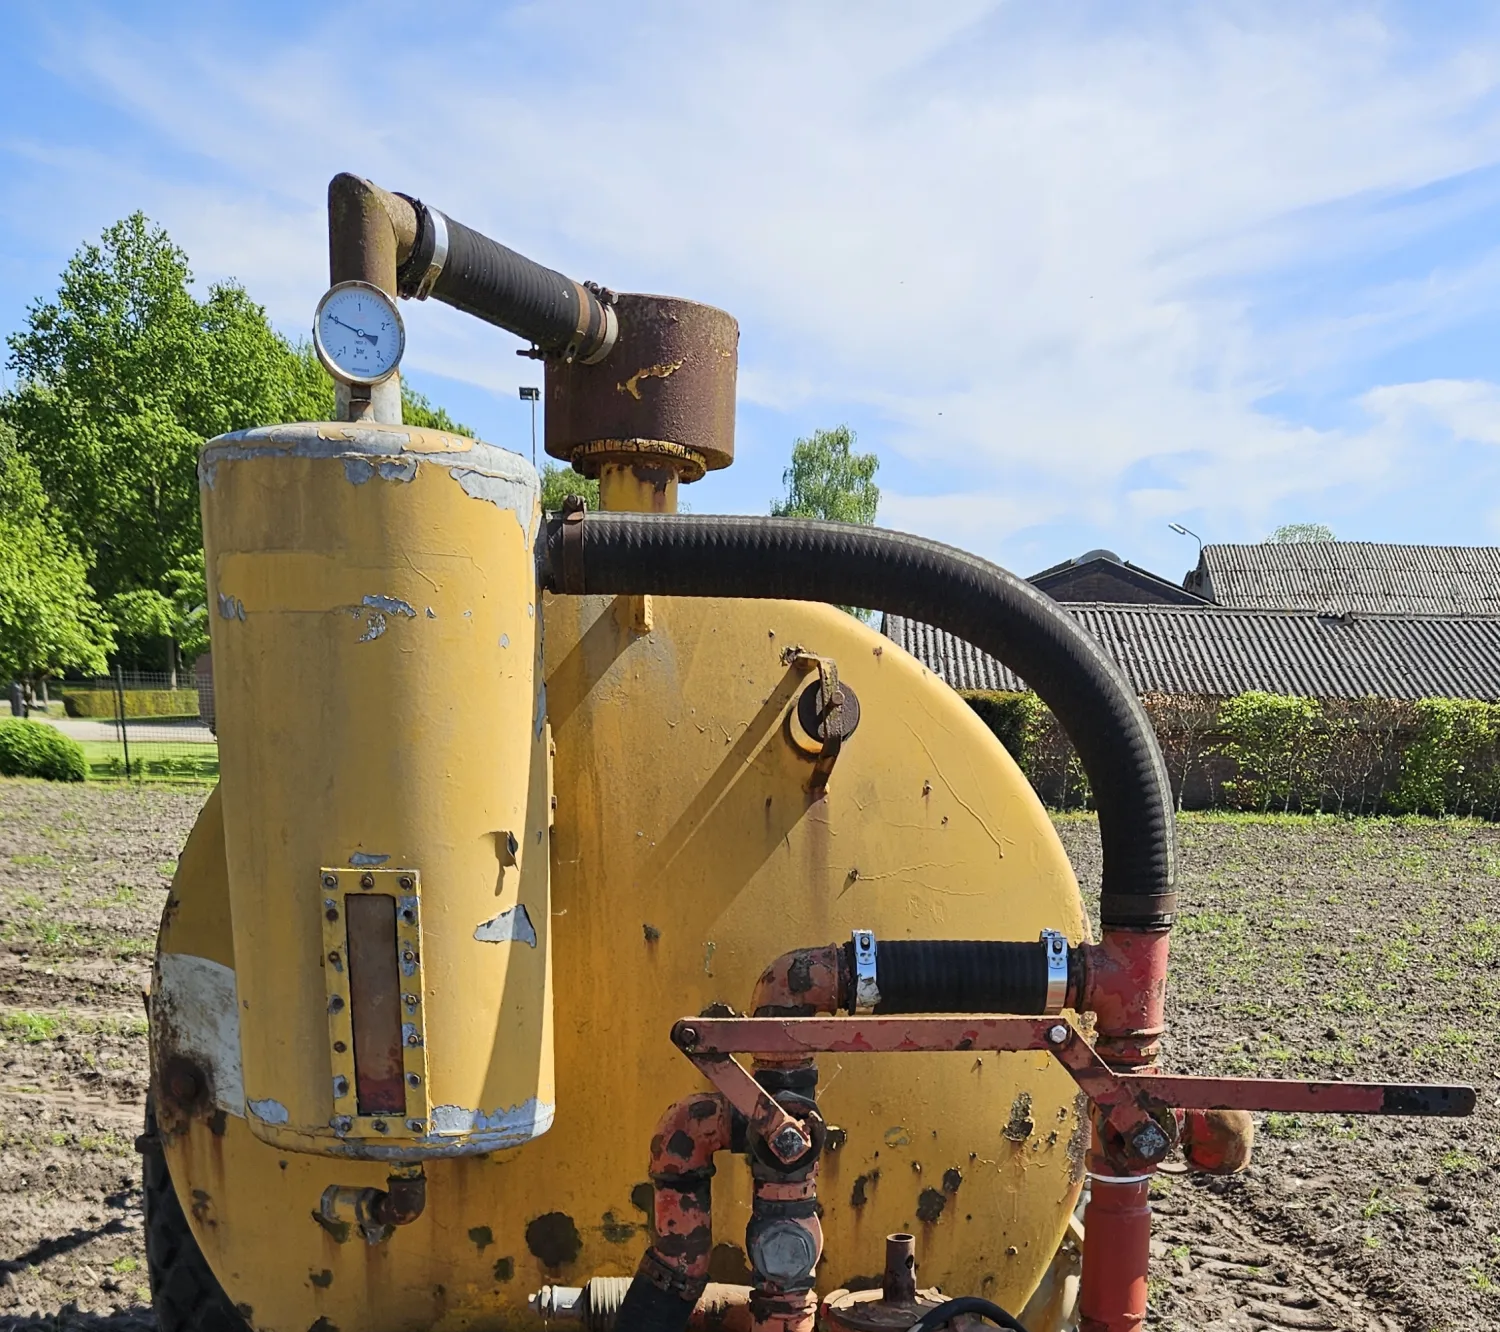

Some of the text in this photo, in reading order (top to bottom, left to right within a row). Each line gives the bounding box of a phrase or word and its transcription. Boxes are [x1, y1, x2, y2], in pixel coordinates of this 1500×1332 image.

[358, 303, 361, 312] 1
[381, 322, 386, 331] 2
[356, 347, 365, 355] bar
[376, 350, 381, 359] 3
